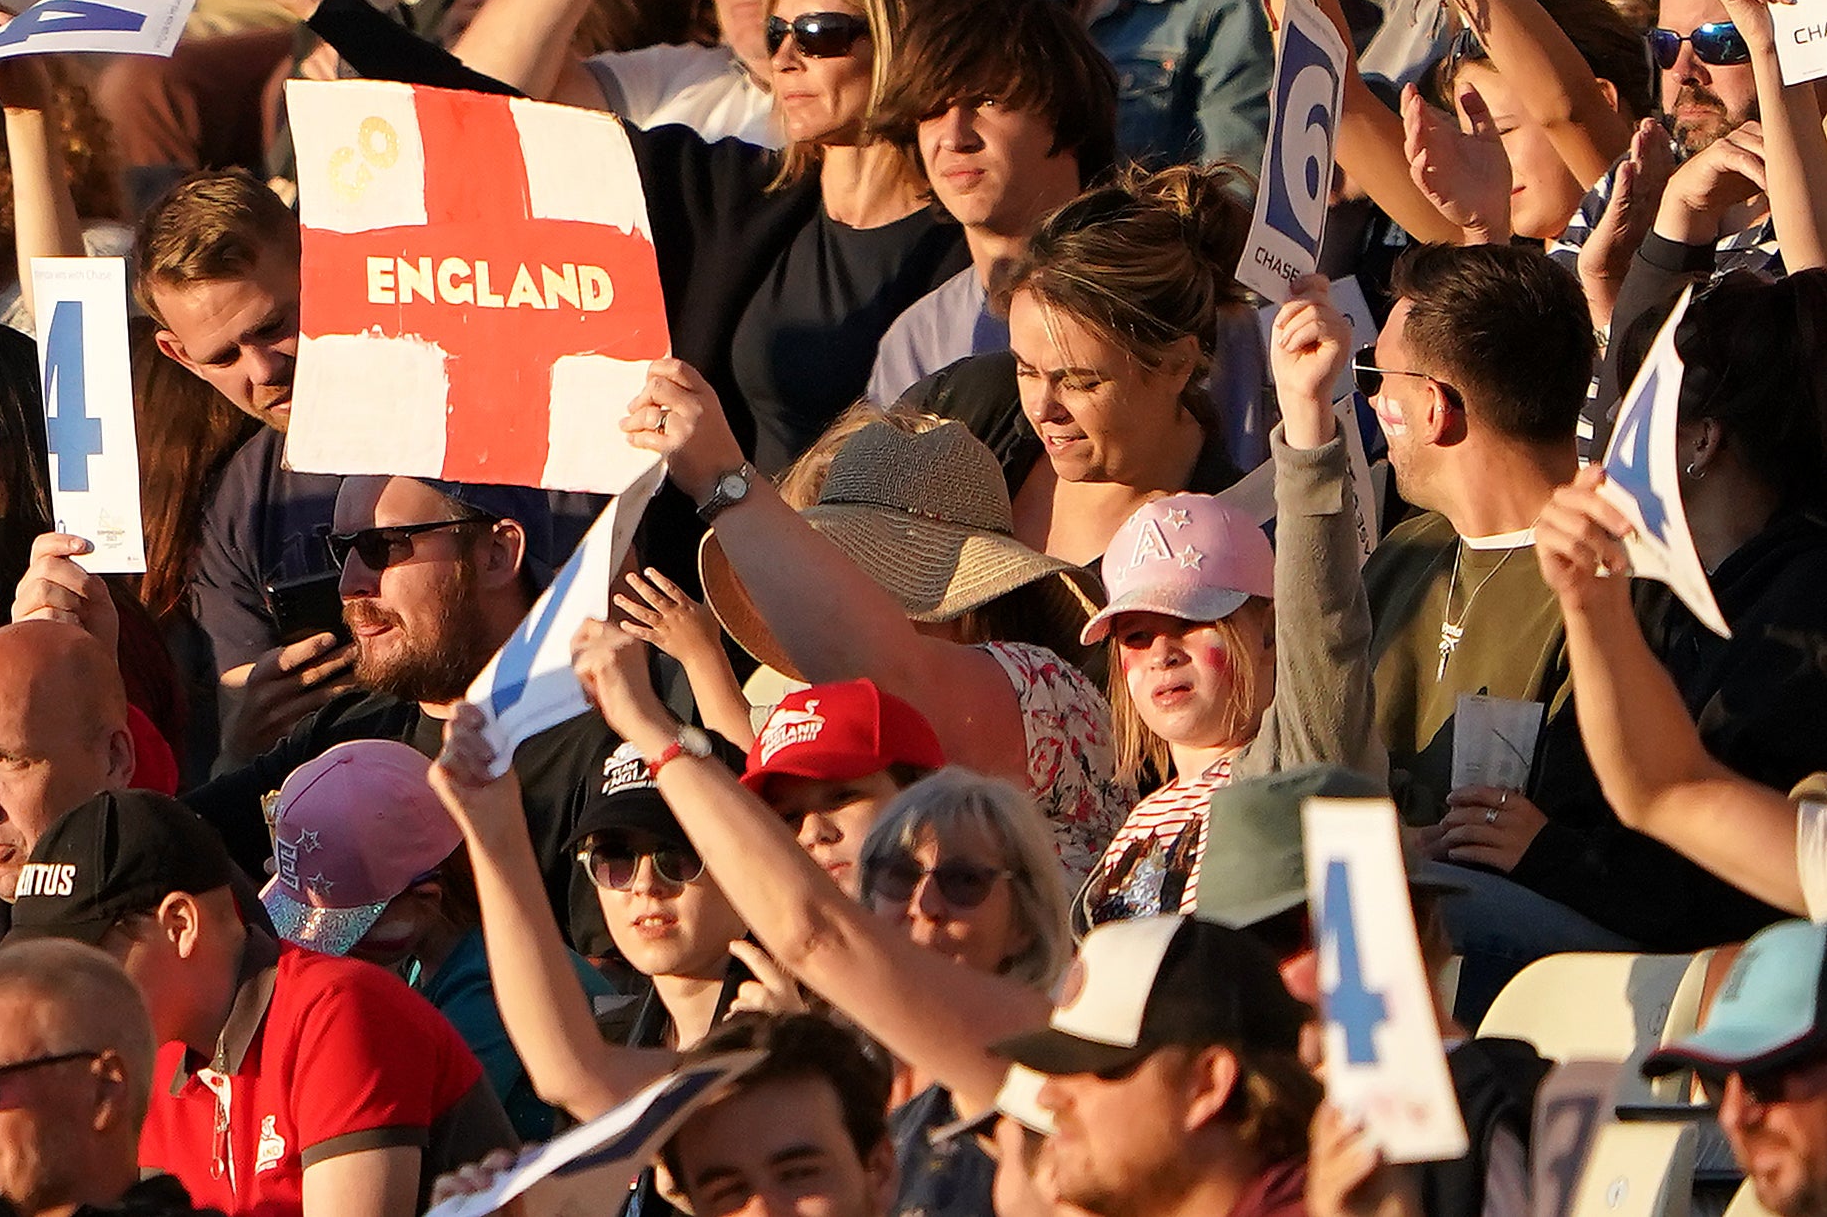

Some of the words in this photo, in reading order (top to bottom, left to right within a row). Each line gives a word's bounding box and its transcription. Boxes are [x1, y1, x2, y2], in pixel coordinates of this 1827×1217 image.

[366, 255, 615, 313] ENGLAND
[1254, 245, 1301, 284] CHASE
[45, 301, 100, 490] 4
[1606, 378, 1664, 538] 4
[1130, 518, 1175, 570] A
[1321, 862, 1386, 1063] 4
